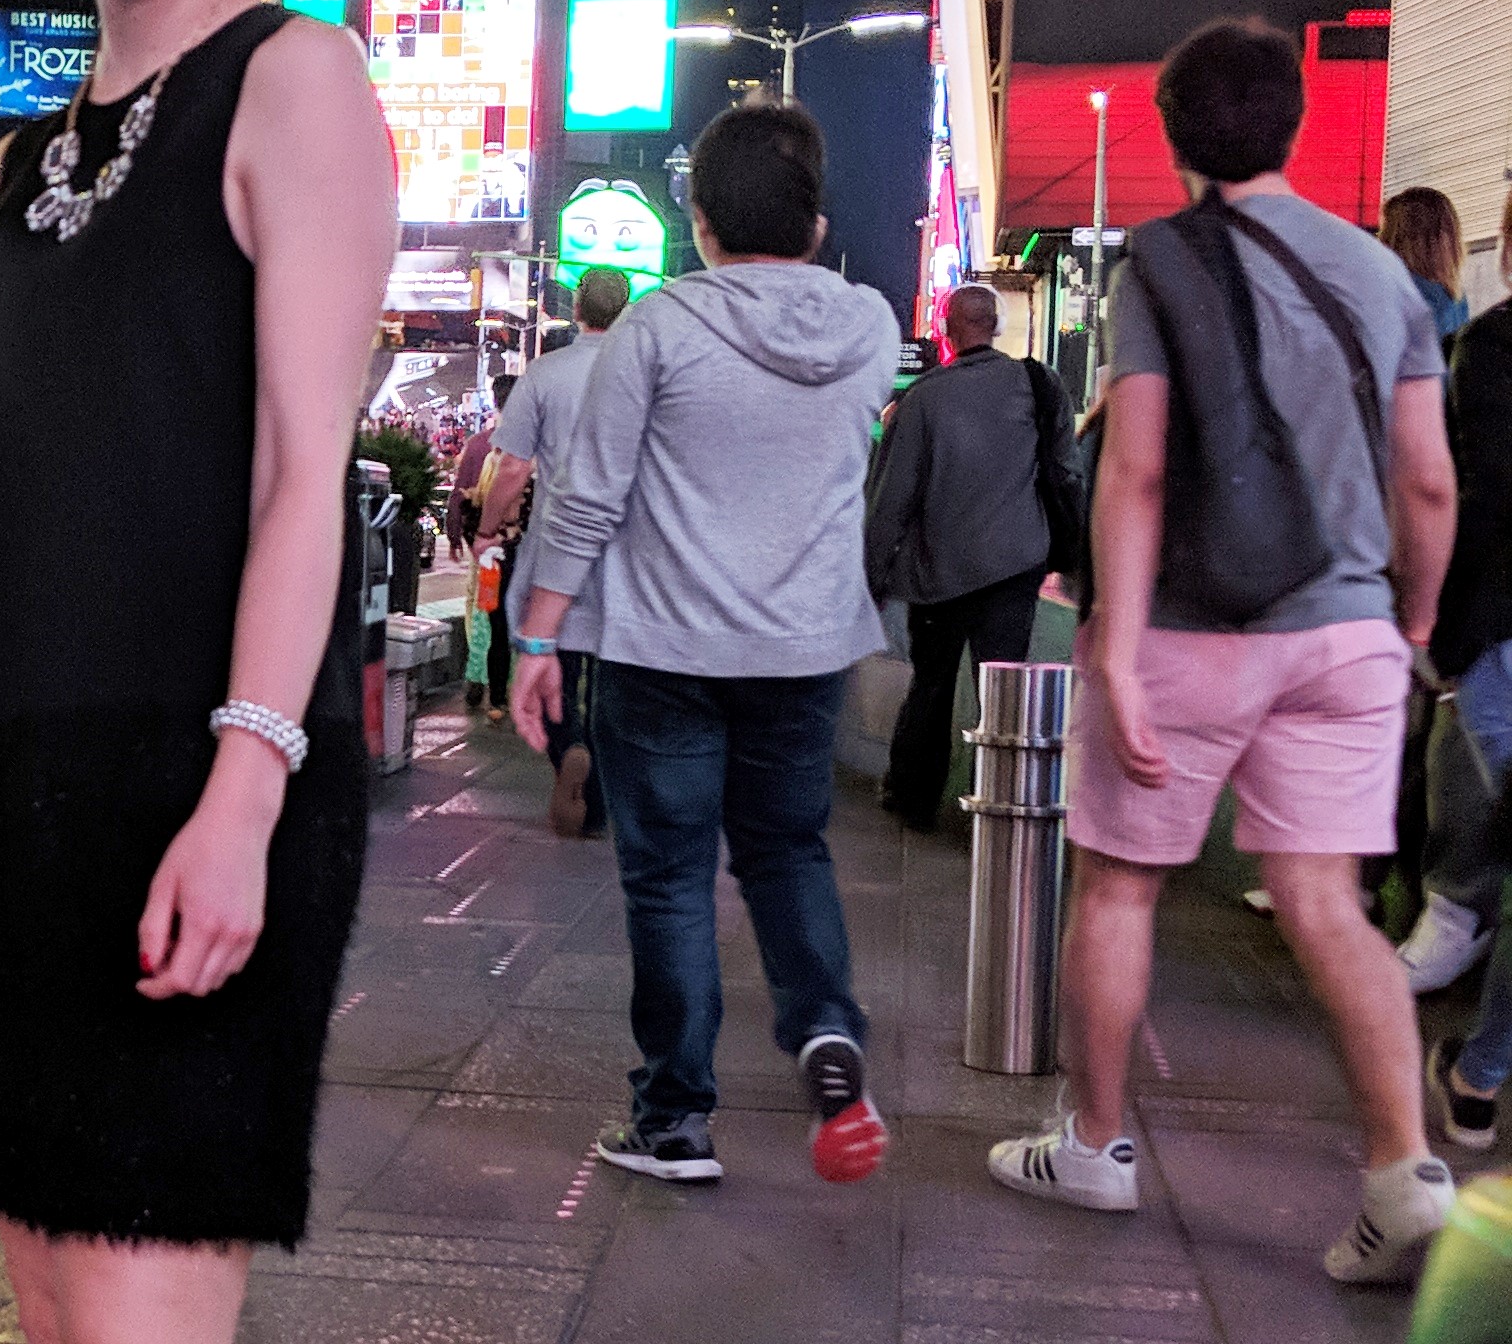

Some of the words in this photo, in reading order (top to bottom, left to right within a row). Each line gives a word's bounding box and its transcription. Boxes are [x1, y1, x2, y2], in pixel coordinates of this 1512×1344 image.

[10, 12, 46, 27] BEST
[50, 13, 100, 29] MUSIC
[9, 40, 96, 81] FROZE
